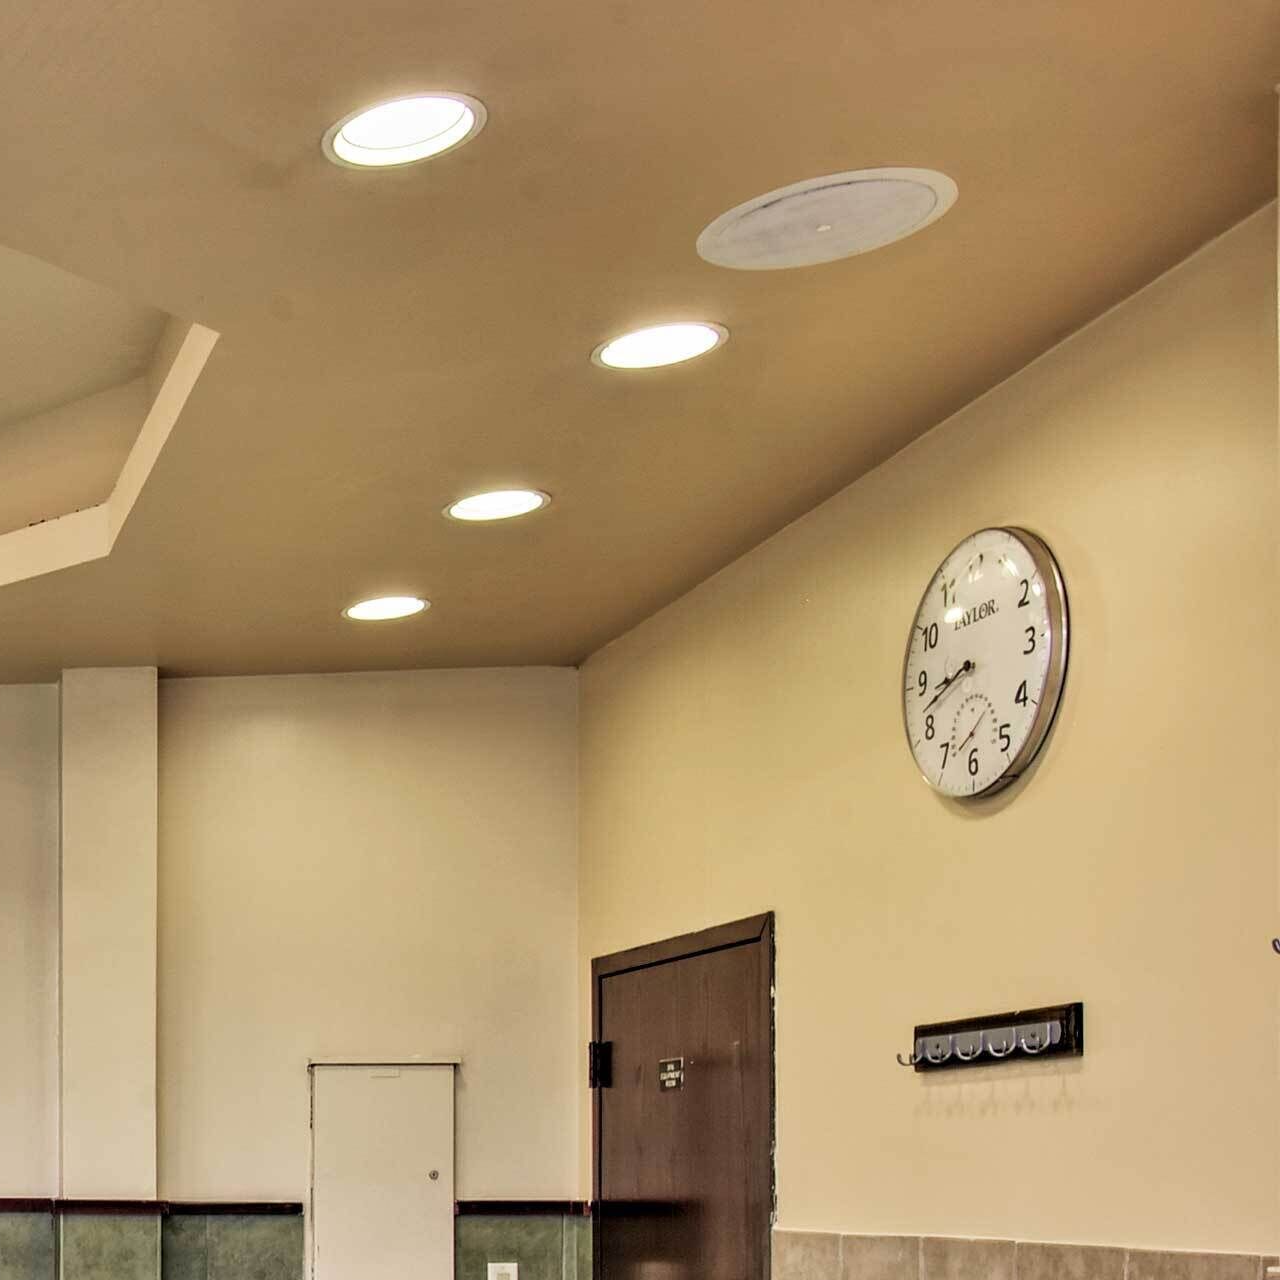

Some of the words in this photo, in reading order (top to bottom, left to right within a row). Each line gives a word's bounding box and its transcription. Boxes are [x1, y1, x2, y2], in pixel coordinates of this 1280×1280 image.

[1017, 578, 1031, 609] 2
[921, 622, 939, 652] 10
[1023, 626, 1036, 655] 3
[918, 670, 928, 697] 9
[1014, 680, 1028, 707] 4
[925, 714, 935, 740] 8
[998, 723, 1011, 753] 5
[939, 742, 950, 769] 7
[967, 748, 979, 776] 6
